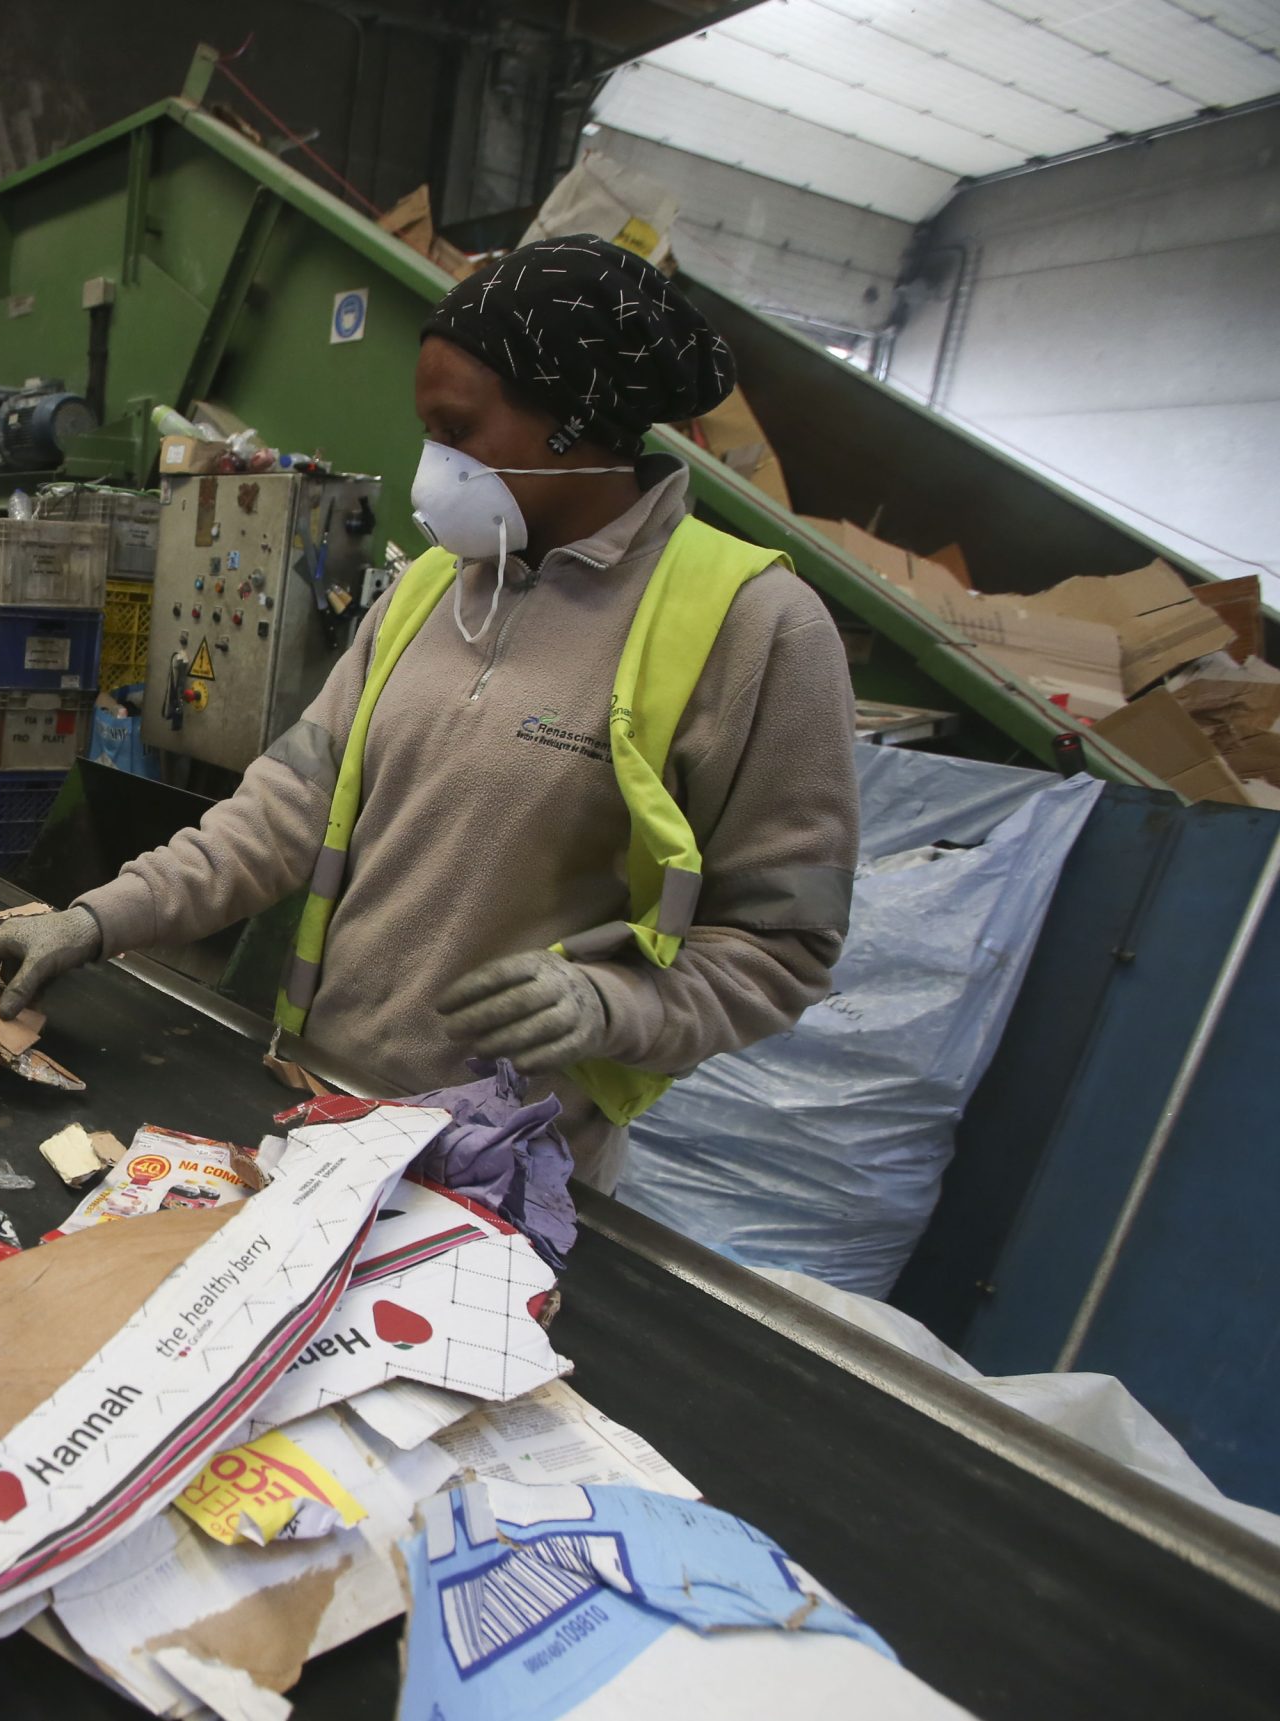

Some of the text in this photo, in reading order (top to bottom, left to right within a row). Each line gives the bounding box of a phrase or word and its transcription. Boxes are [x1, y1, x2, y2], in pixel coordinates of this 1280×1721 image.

[179, 1160, 253, 1190] NA COMP
[156, 1234, 271, 1357] the healthy berry
[24, 1385, 143, 1486] Hannah
